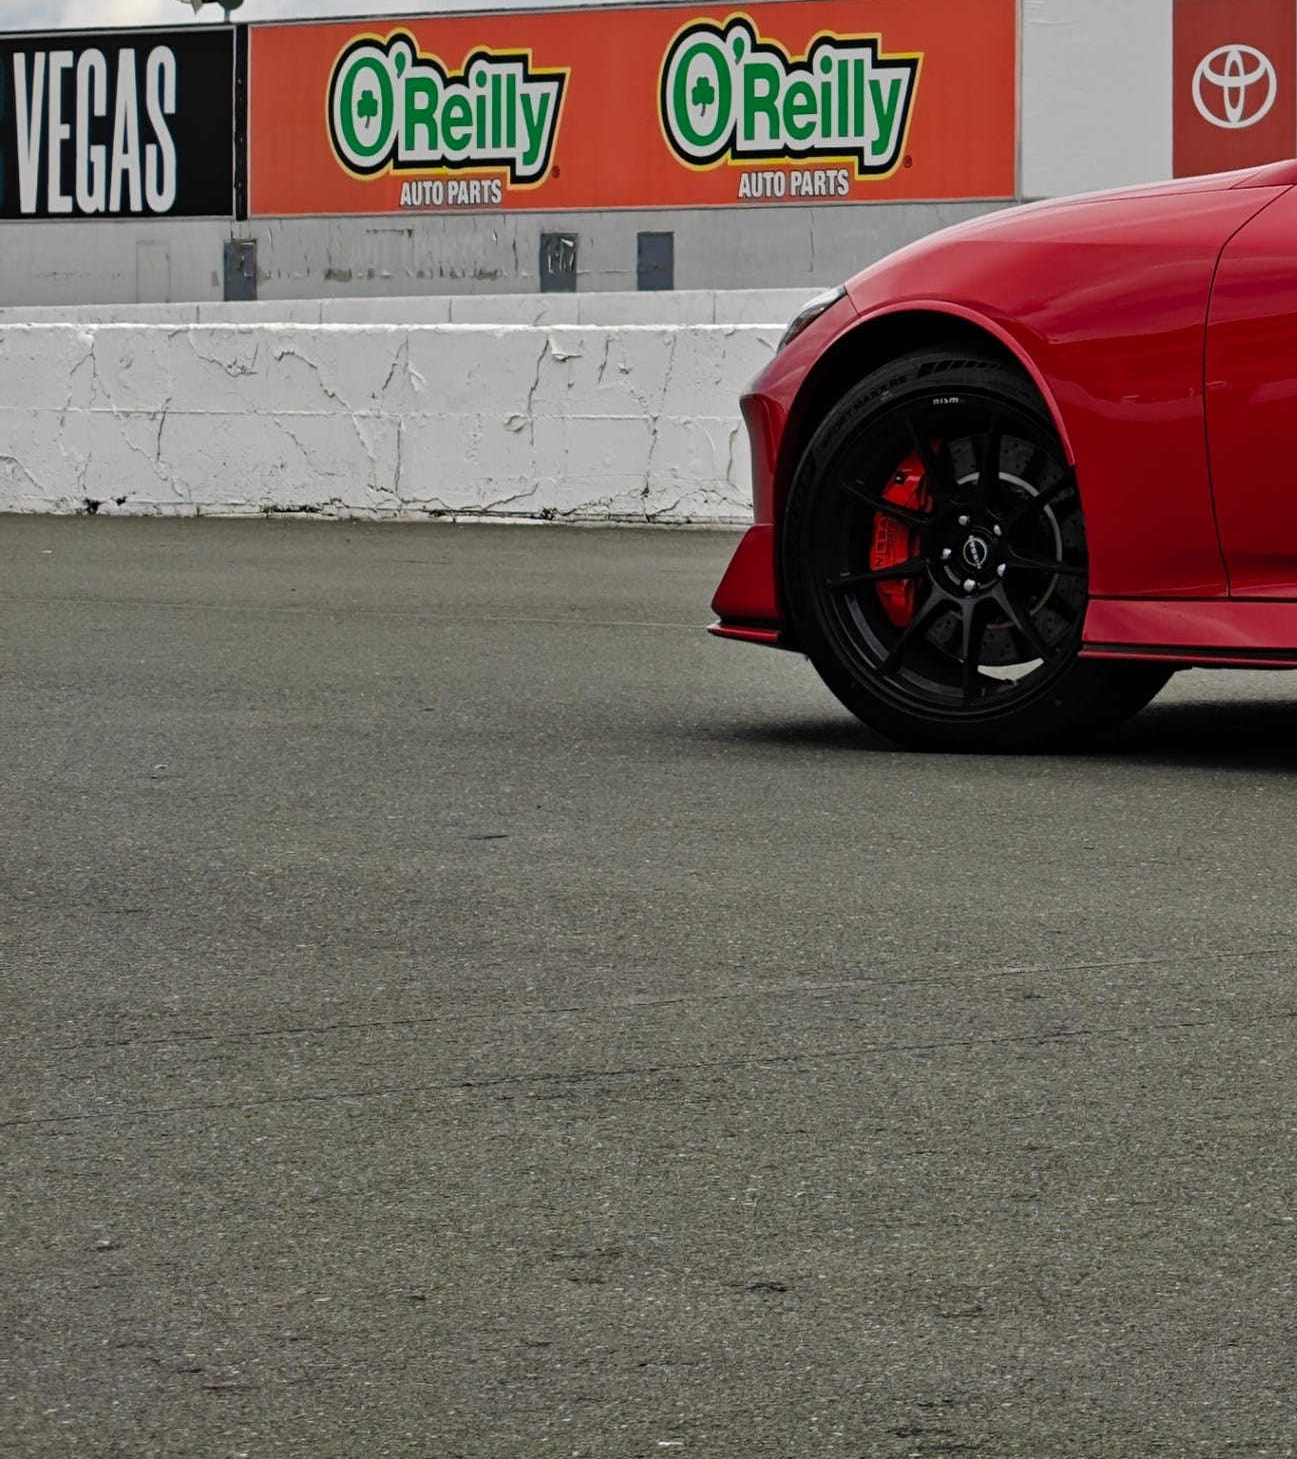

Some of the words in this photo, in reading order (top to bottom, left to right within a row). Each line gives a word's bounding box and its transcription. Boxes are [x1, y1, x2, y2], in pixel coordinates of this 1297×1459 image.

[13, 45, 177, 214] VEGAS
[339, 50, 551, 167] O'Reilly
[672, 36, 902, 157] O'Reilly
[400, 181, 443, 206] AUTO
[446, 179, 503, 205] PARTS
[737, 172, 786, 198] AUTO
[789, 169, 850, 197] PARTS
